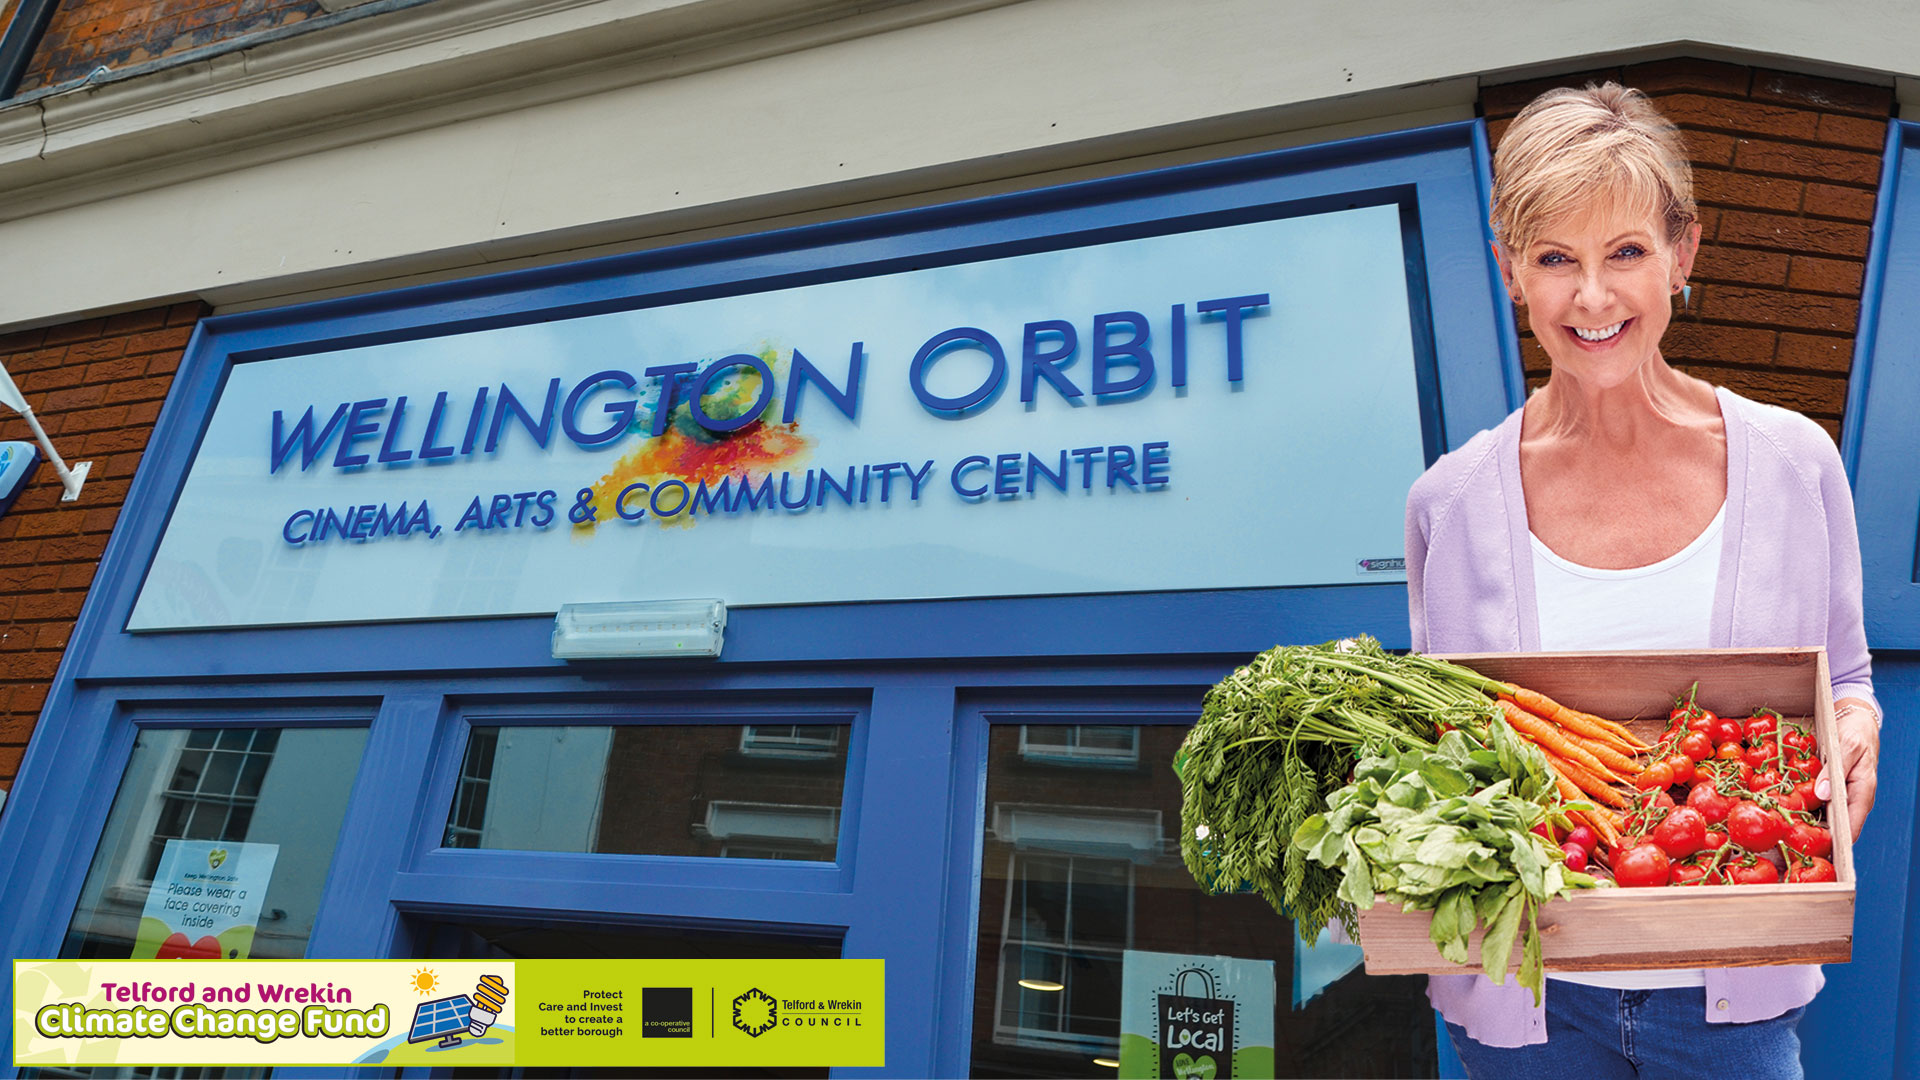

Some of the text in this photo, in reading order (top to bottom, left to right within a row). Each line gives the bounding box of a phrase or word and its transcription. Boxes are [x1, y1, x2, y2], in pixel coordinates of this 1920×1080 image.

[271, 293, 1270, 474] WELLINGTON ORBIT
[282, 441, 1169, 545] CINEMA, ARTS & COMMUNITY CENTRE
[167, 883, 247, 899] Please wear a
[164, 898, 241, 917] face covering
[182, 914, 214, 928] inside
[1168, 1007, 1225, 1024] Let's Get
